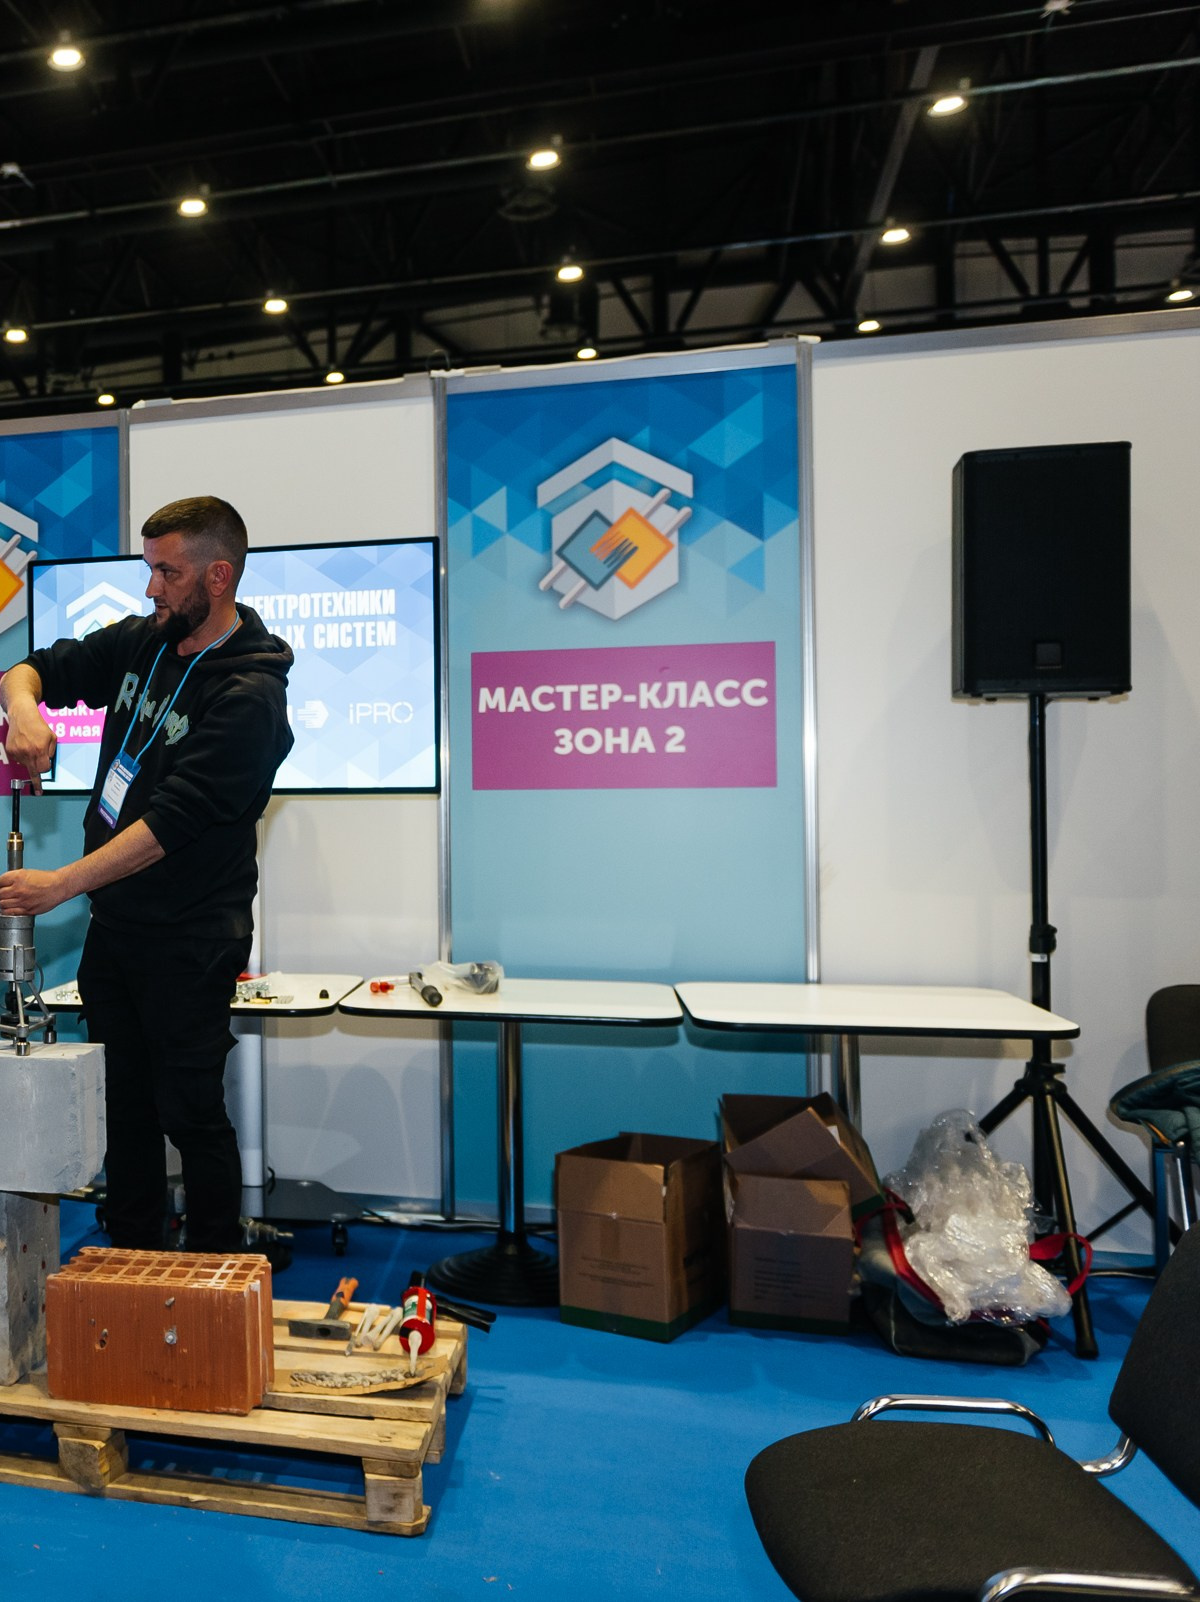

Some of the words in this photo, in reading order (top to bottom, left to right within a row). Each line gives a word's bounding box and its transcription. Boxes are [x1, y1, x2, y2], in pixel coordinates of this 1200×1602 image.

[236, 589, 396, 620] ЛЕКТРОТЕХНИКИ
[267, 624, 306, 650] ЫХ
[313, 620, 397, 650] СИСТЕМ
[478, 679, 768, 713] МАСТЕР-КЛАСС
[349, 702, 413, 724] iPRO
[69, 725, 101, 737] мая
[554, 726, 656, 755] ЗОНА
[665, 726, 686, 753] 2
